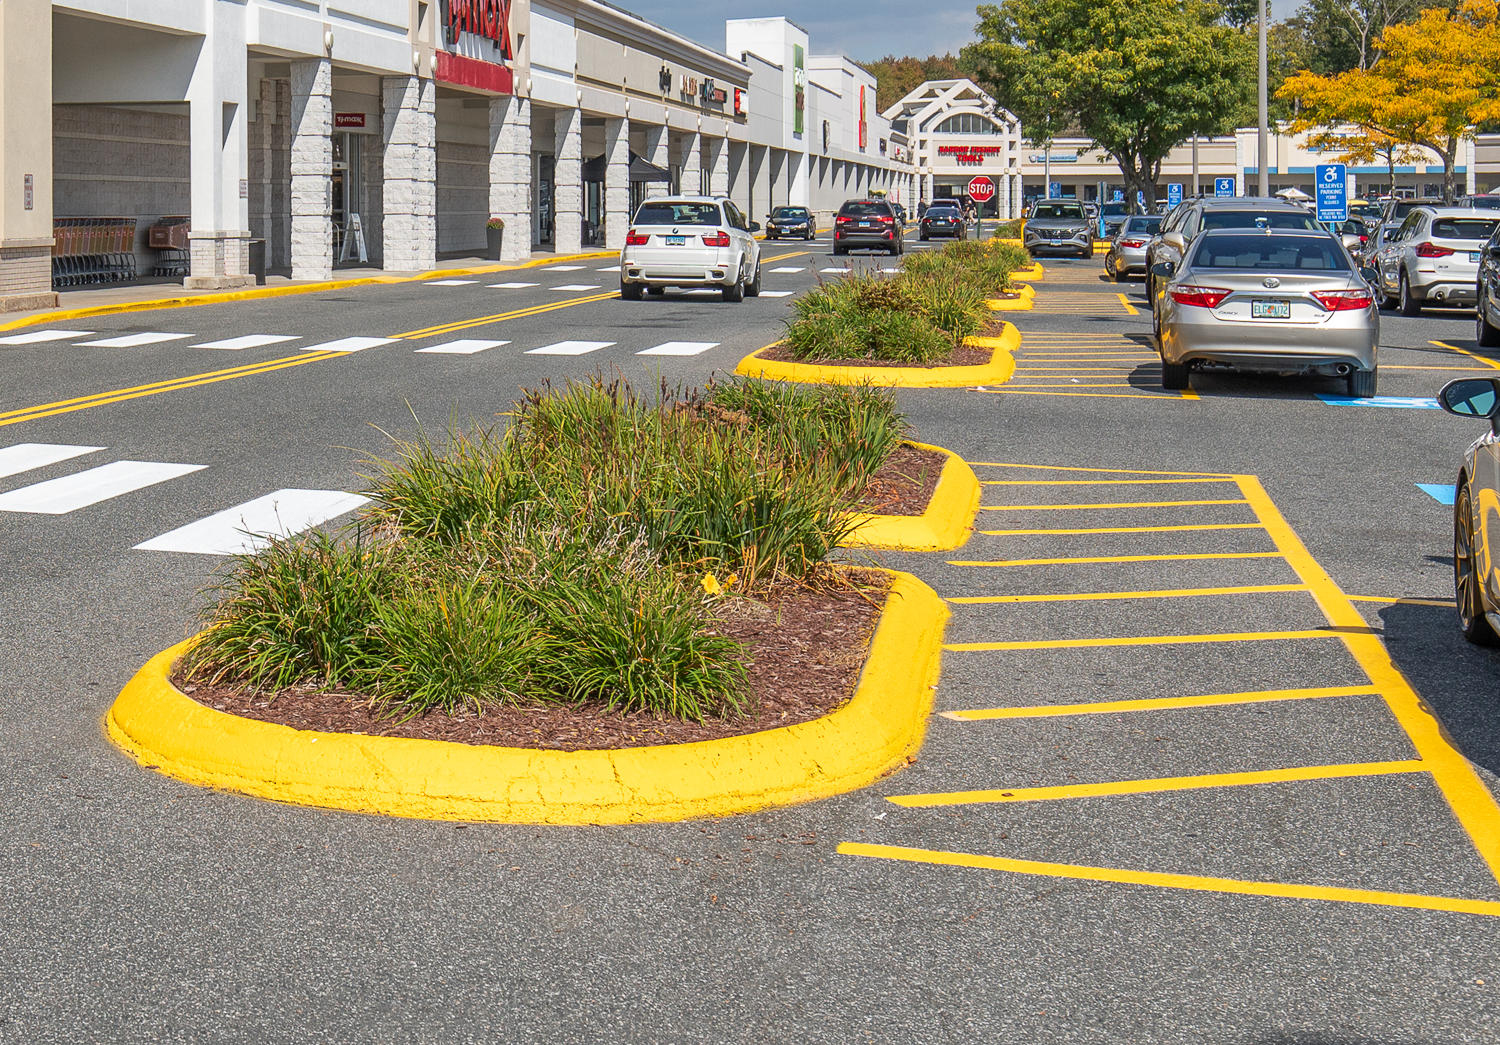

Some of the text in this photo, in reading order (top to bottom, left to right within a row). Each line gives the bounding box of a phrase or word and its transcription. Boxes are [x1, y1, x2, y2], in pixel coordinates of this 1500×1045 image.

[938, 145, 970, 153] HARBOR
[957, 154, 985, 162] TOOLS
[969, 183, 994, 195] STOP
